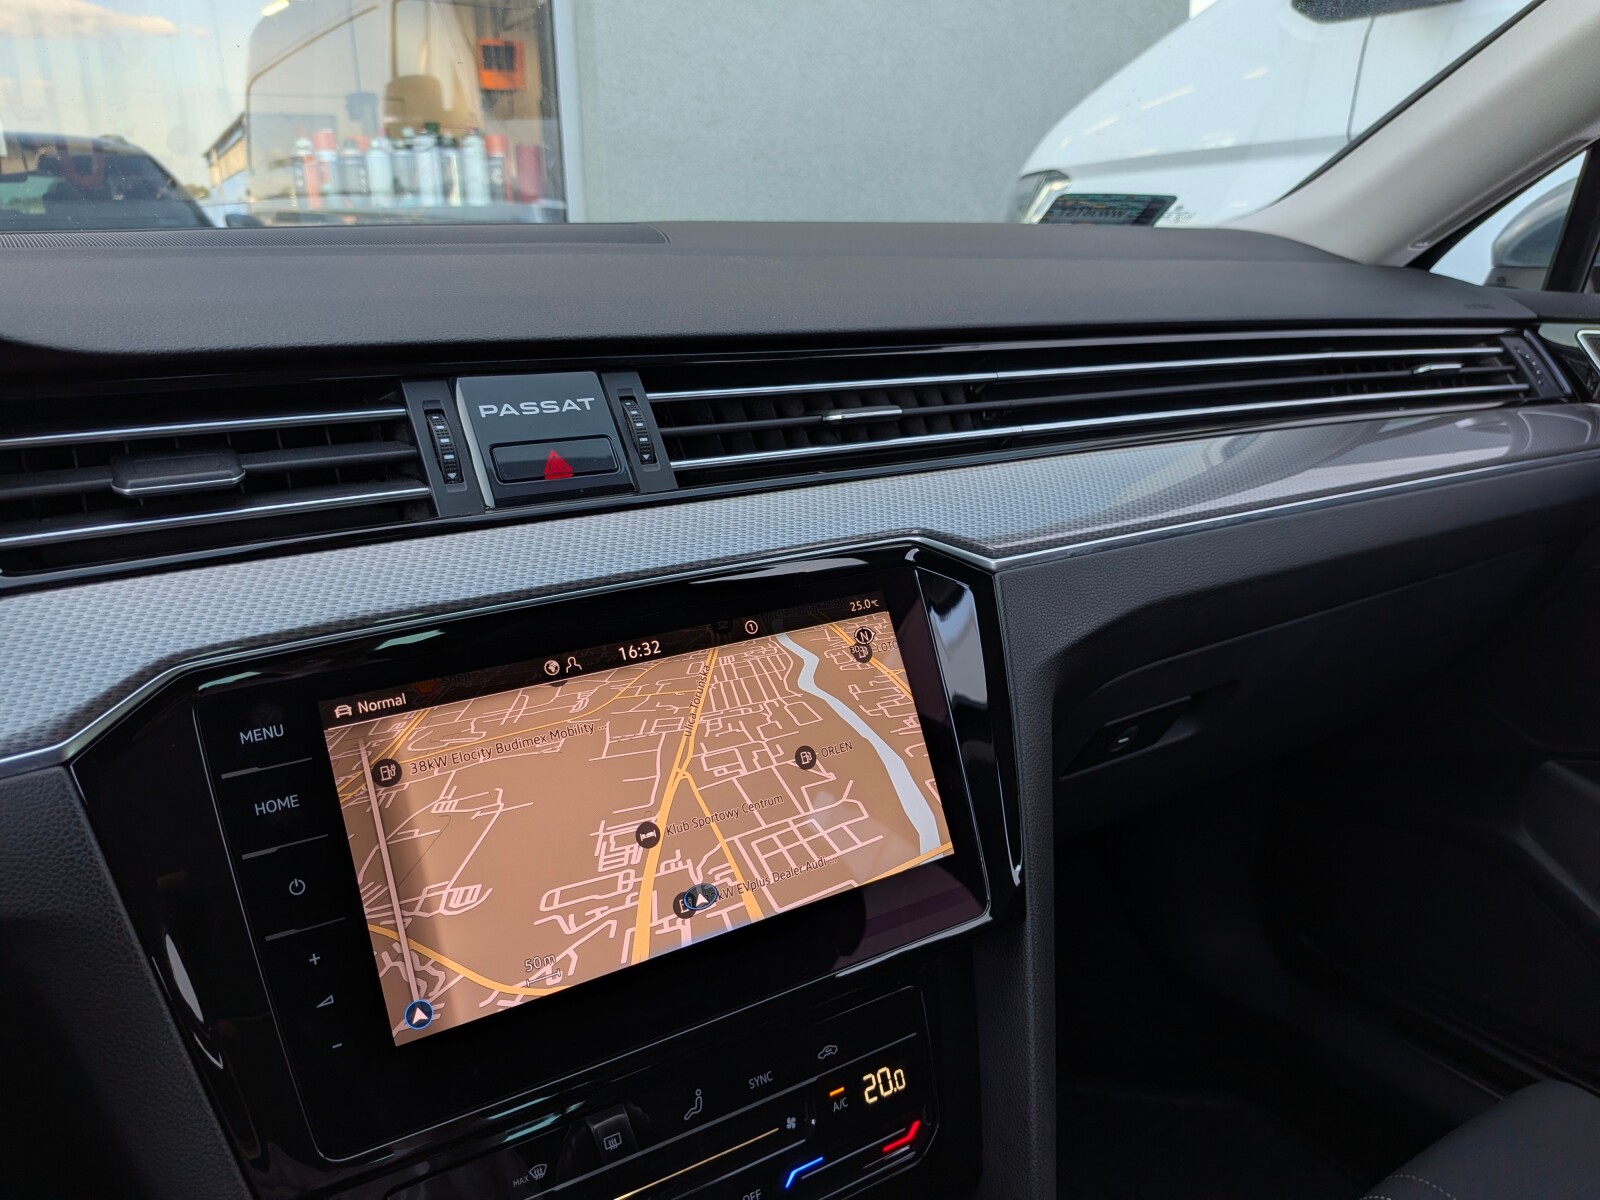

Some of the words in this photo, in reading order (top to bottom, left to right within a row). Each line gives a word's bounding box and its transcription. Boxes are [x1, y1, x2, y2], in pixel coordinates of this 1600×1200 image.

[479, 398, 595, 418] PASSAT
[860, 631, 869, 641] N
[618, 640, 662, 661] 16:32
[357, 693, 407, 714] Normal
[239, 723, 285, 745] MENU
[684, 712, 697, 737] ulica
[409, 755, 448, 775] 38kW
[451, 745, 492, 765] Elocity
[495, 733, 547, 754] Budimex
[550, 722, 595, 742] Mobility
[821, 741, 853, 759] ORLEN
[254, 794, 300, 816] HOME
[666, 817, 689, 837] Klub
[691, 806, 739, 830] Sportowy
[741, 794, 784, 815] Centrum
[772, 865, 804, 883] Dealer
[805, 856, 827, 873] Audi
[748, 1070, 774, 1090] SYNC
[863, 1066, 906, 1104] 20.0
[832, 1097, 849, 1113] A/C
[512, 1174, 530, 1188] MAX
[742, 1188, 763, 1200] OFF
